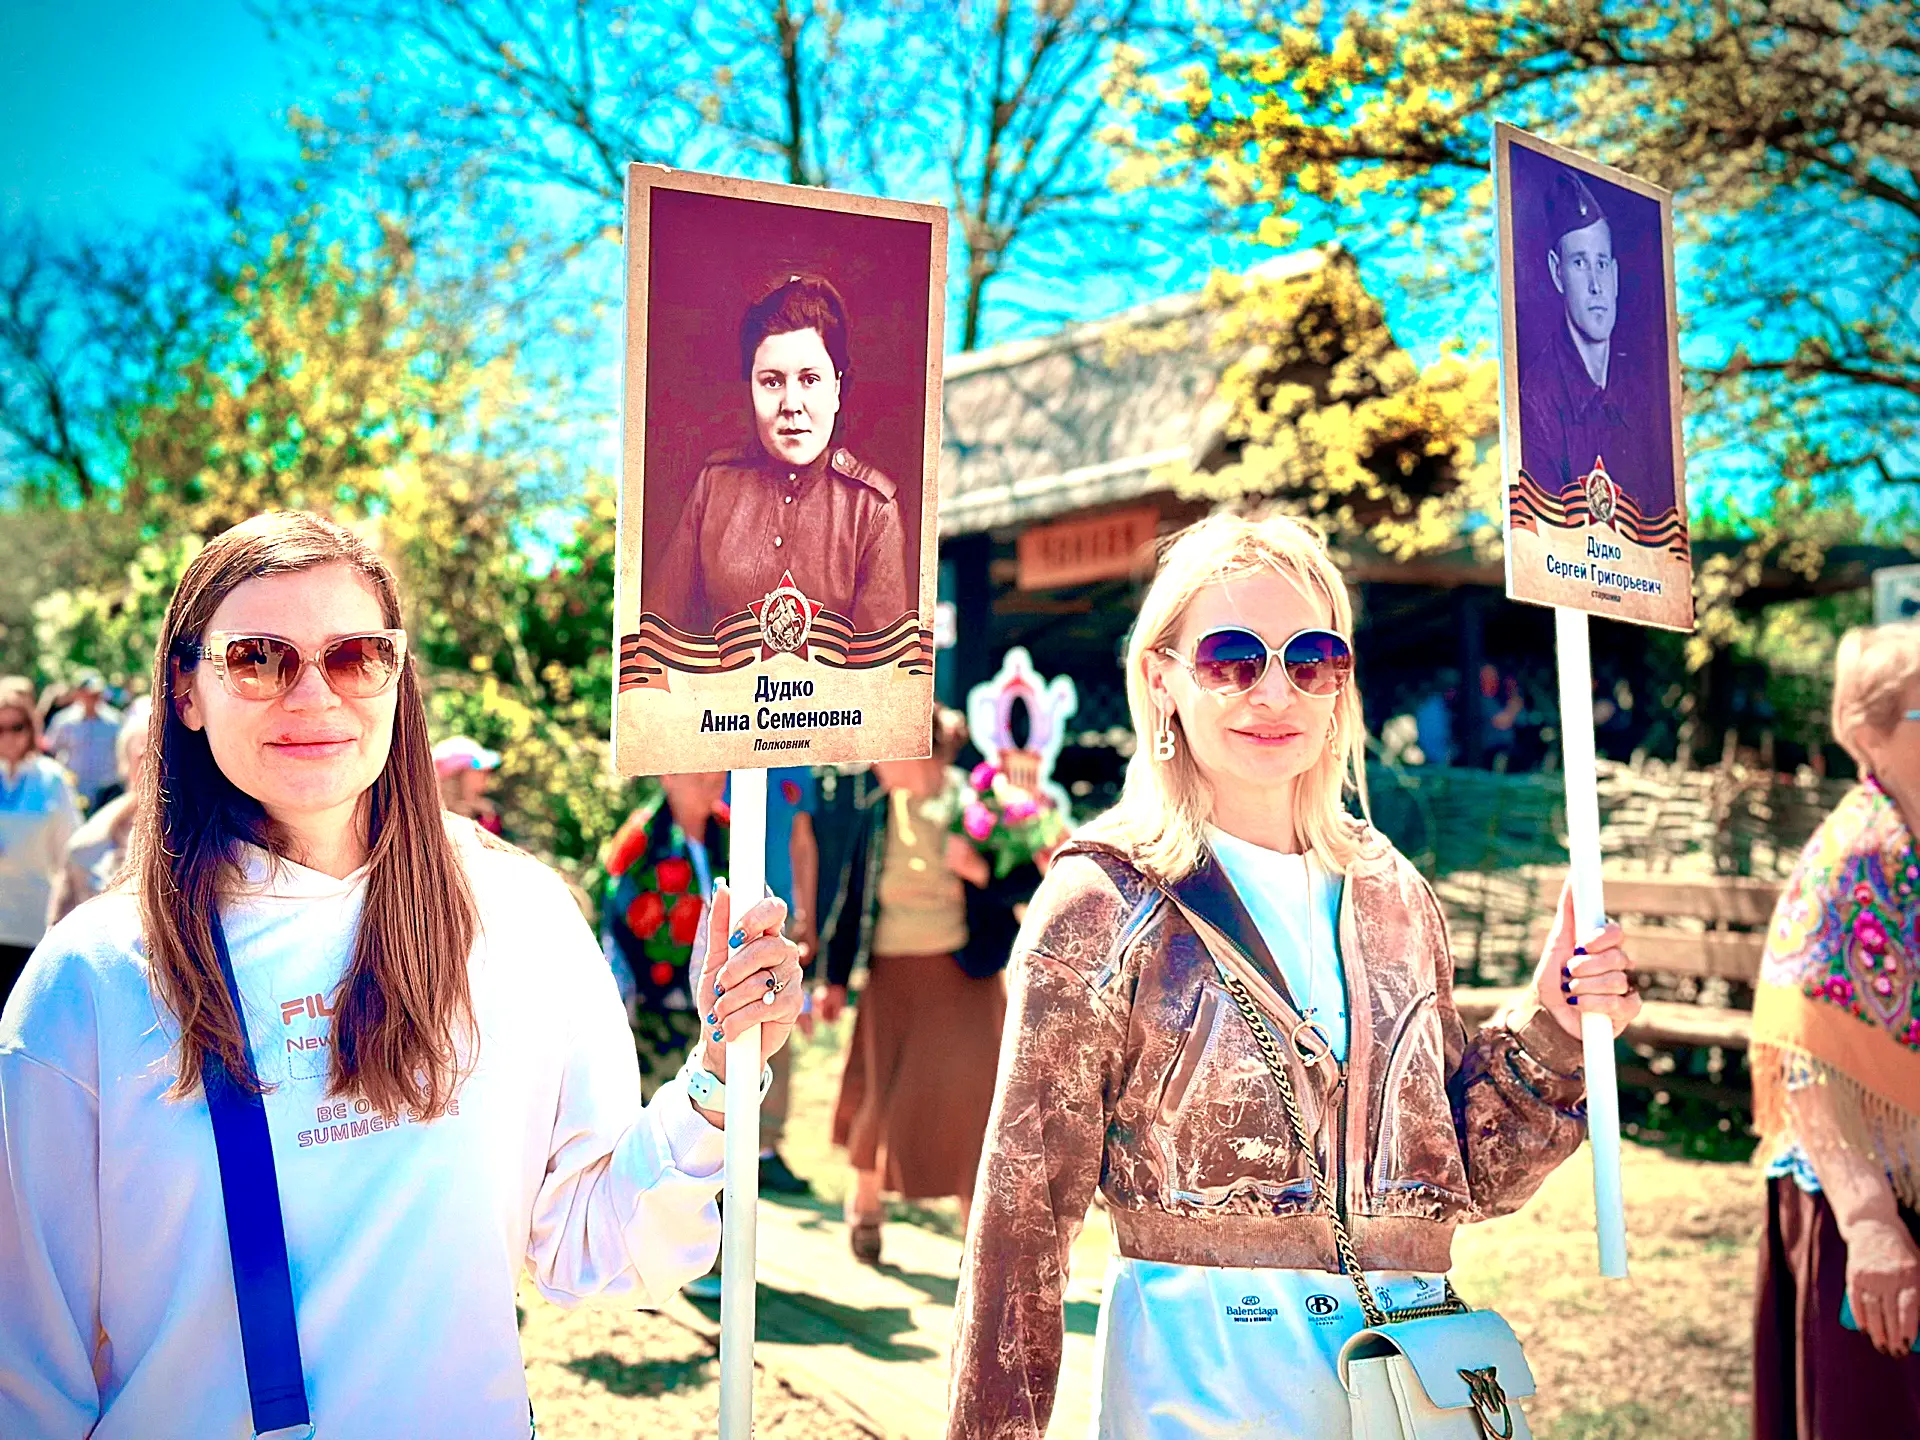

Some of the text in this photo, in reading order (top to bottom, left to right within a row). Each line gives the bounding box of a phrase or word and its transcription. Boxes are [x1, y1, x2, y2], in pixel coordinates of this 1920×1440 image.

[1587, 536, 1621, 560] Дудко
[1546, 555, 1662, 595] Сергей Григорьевич
[754, 676, 814, 703] Дудко
[700, 708, 862, 733] Анна Семеновна
[753, 738, 811, 752] Полковник
[280, 993, 337, 1026] FIL
[297, 1100, 460, 1148] SUMMER SDE
[317, 1103, 347, 1123] BE
[1226, 1305, 1279, 1317] Balenciaga
